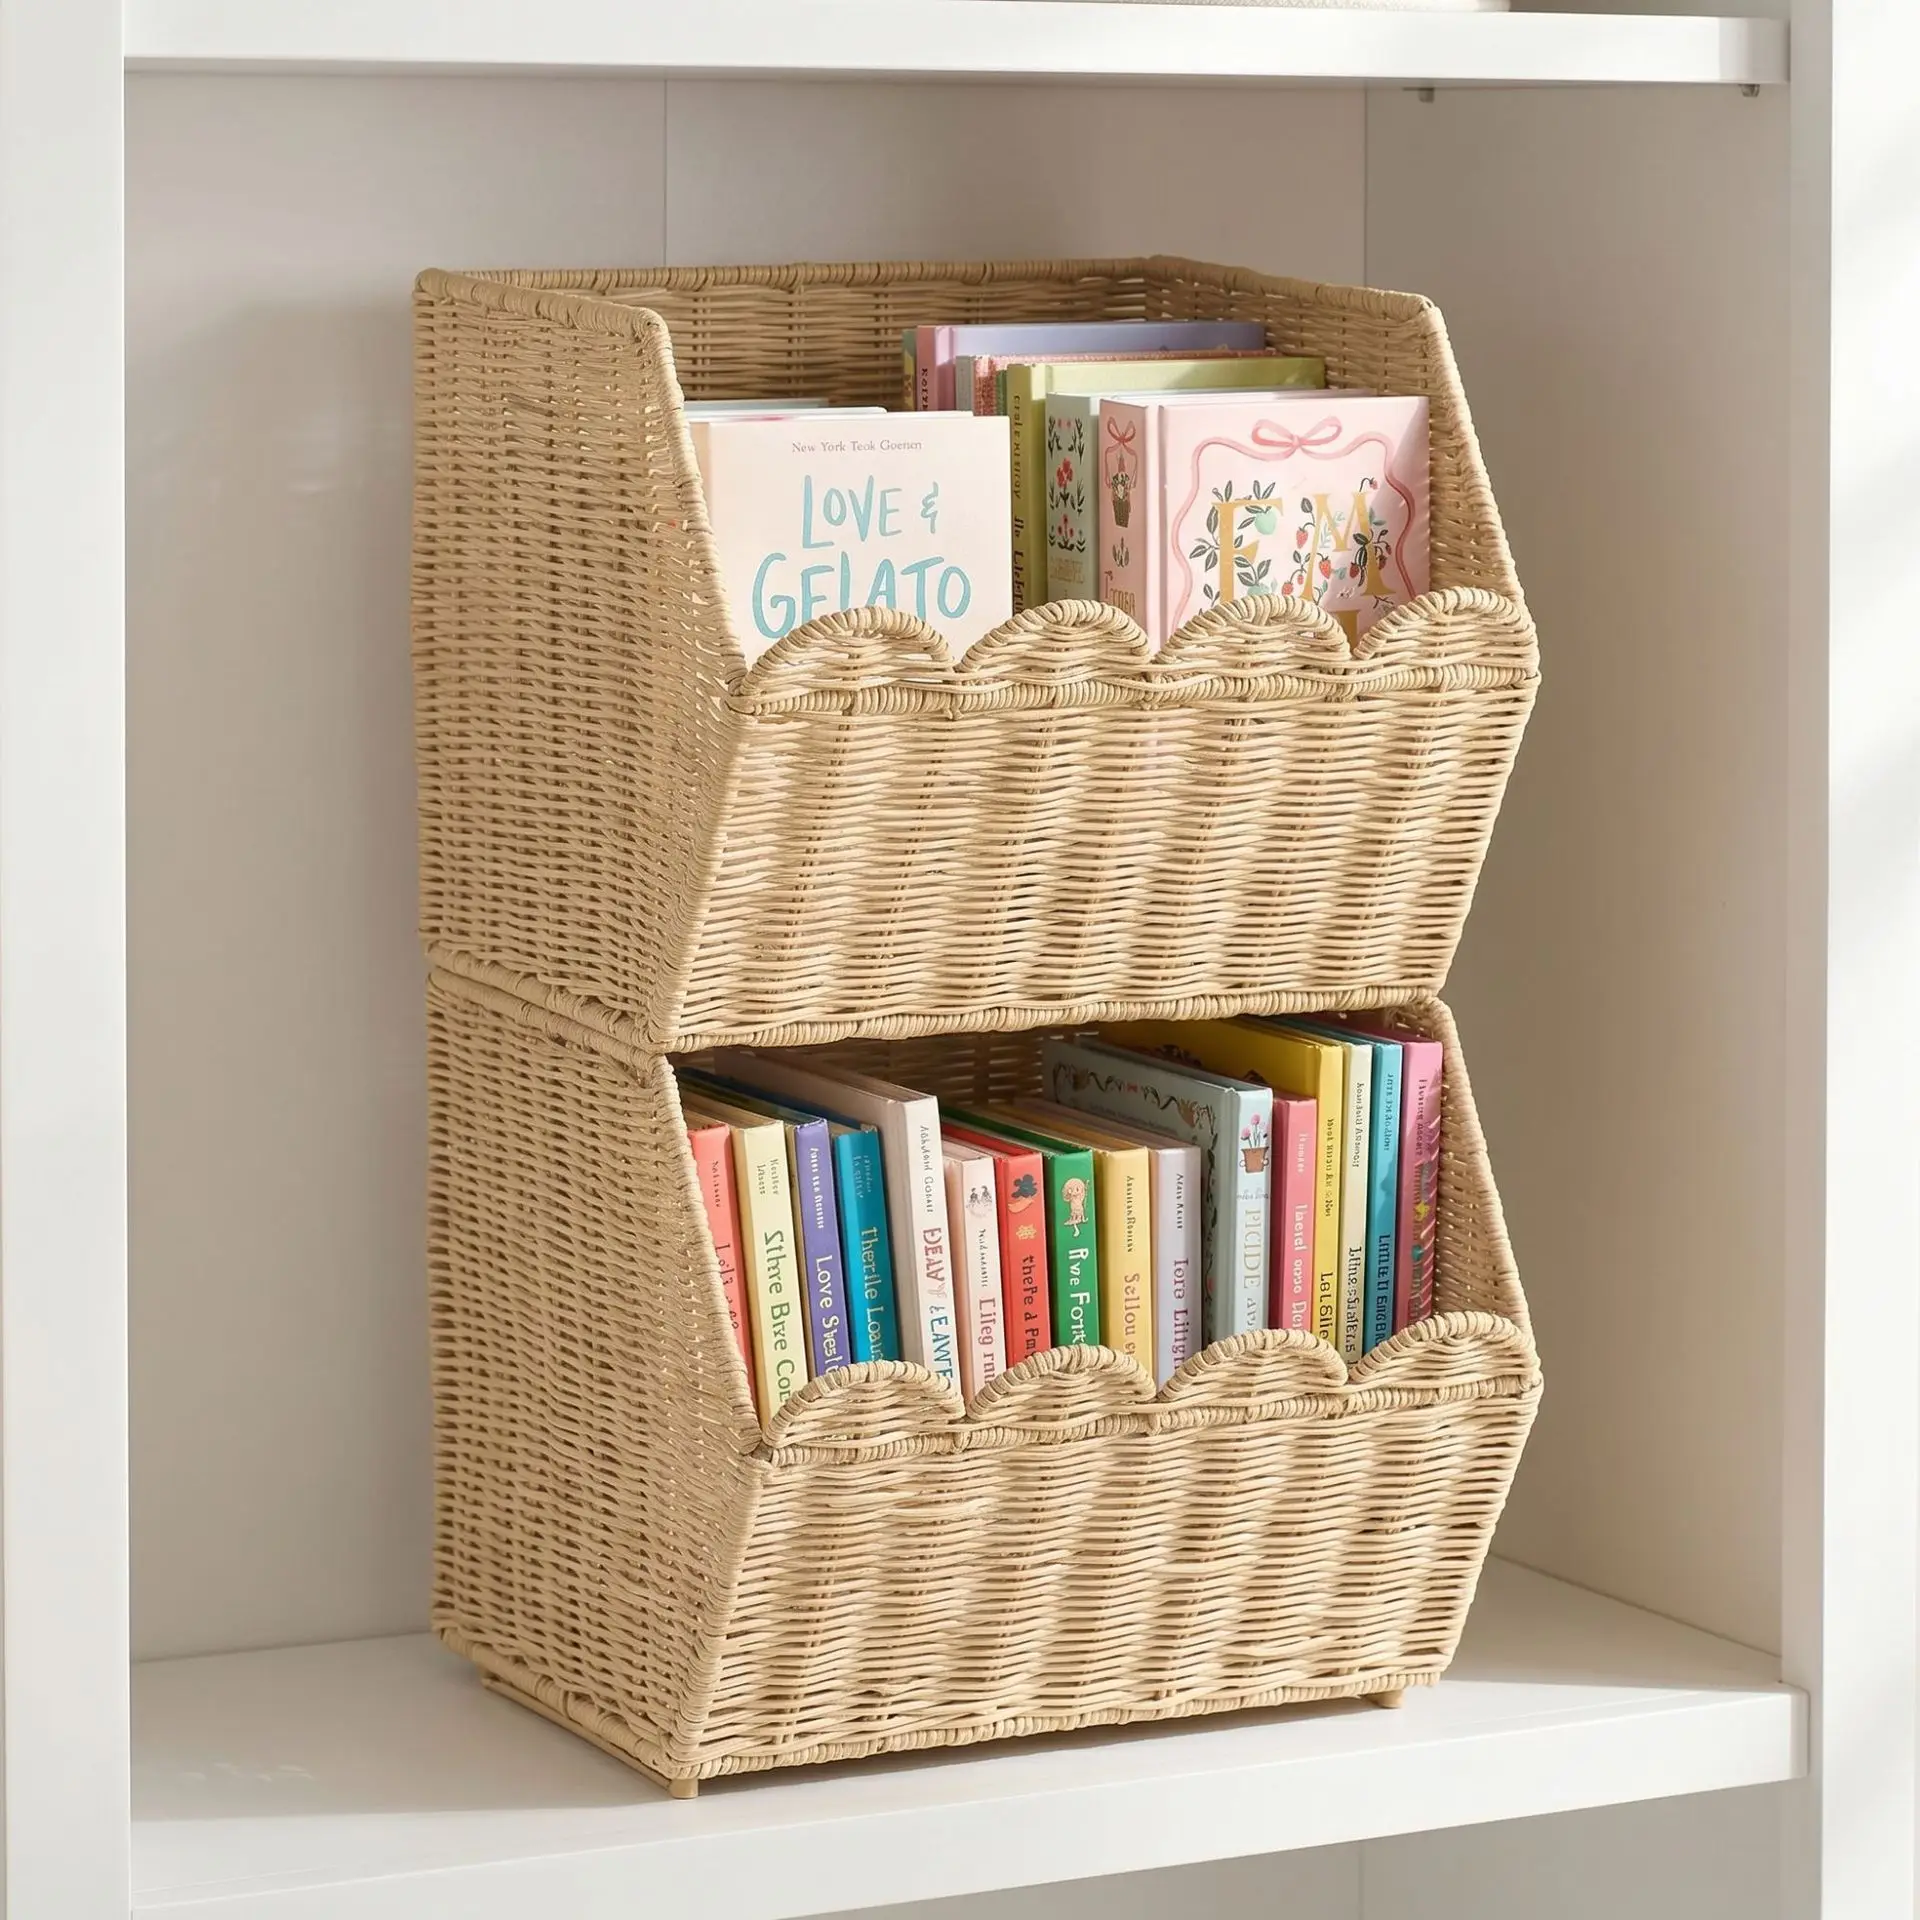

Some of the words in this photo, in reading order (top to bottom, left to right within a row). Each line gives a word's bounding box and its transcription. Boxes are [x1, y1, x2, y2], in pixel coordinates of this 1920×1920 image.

[792, 441, 815, 452] New
[820, 440, 846, 452] York
[802, 474, 902, 549] LOVE
[919, 481, 939, 534] &
[752, 551, 971, 639] GELATO
[815, 1255, 837, 1309] Love
